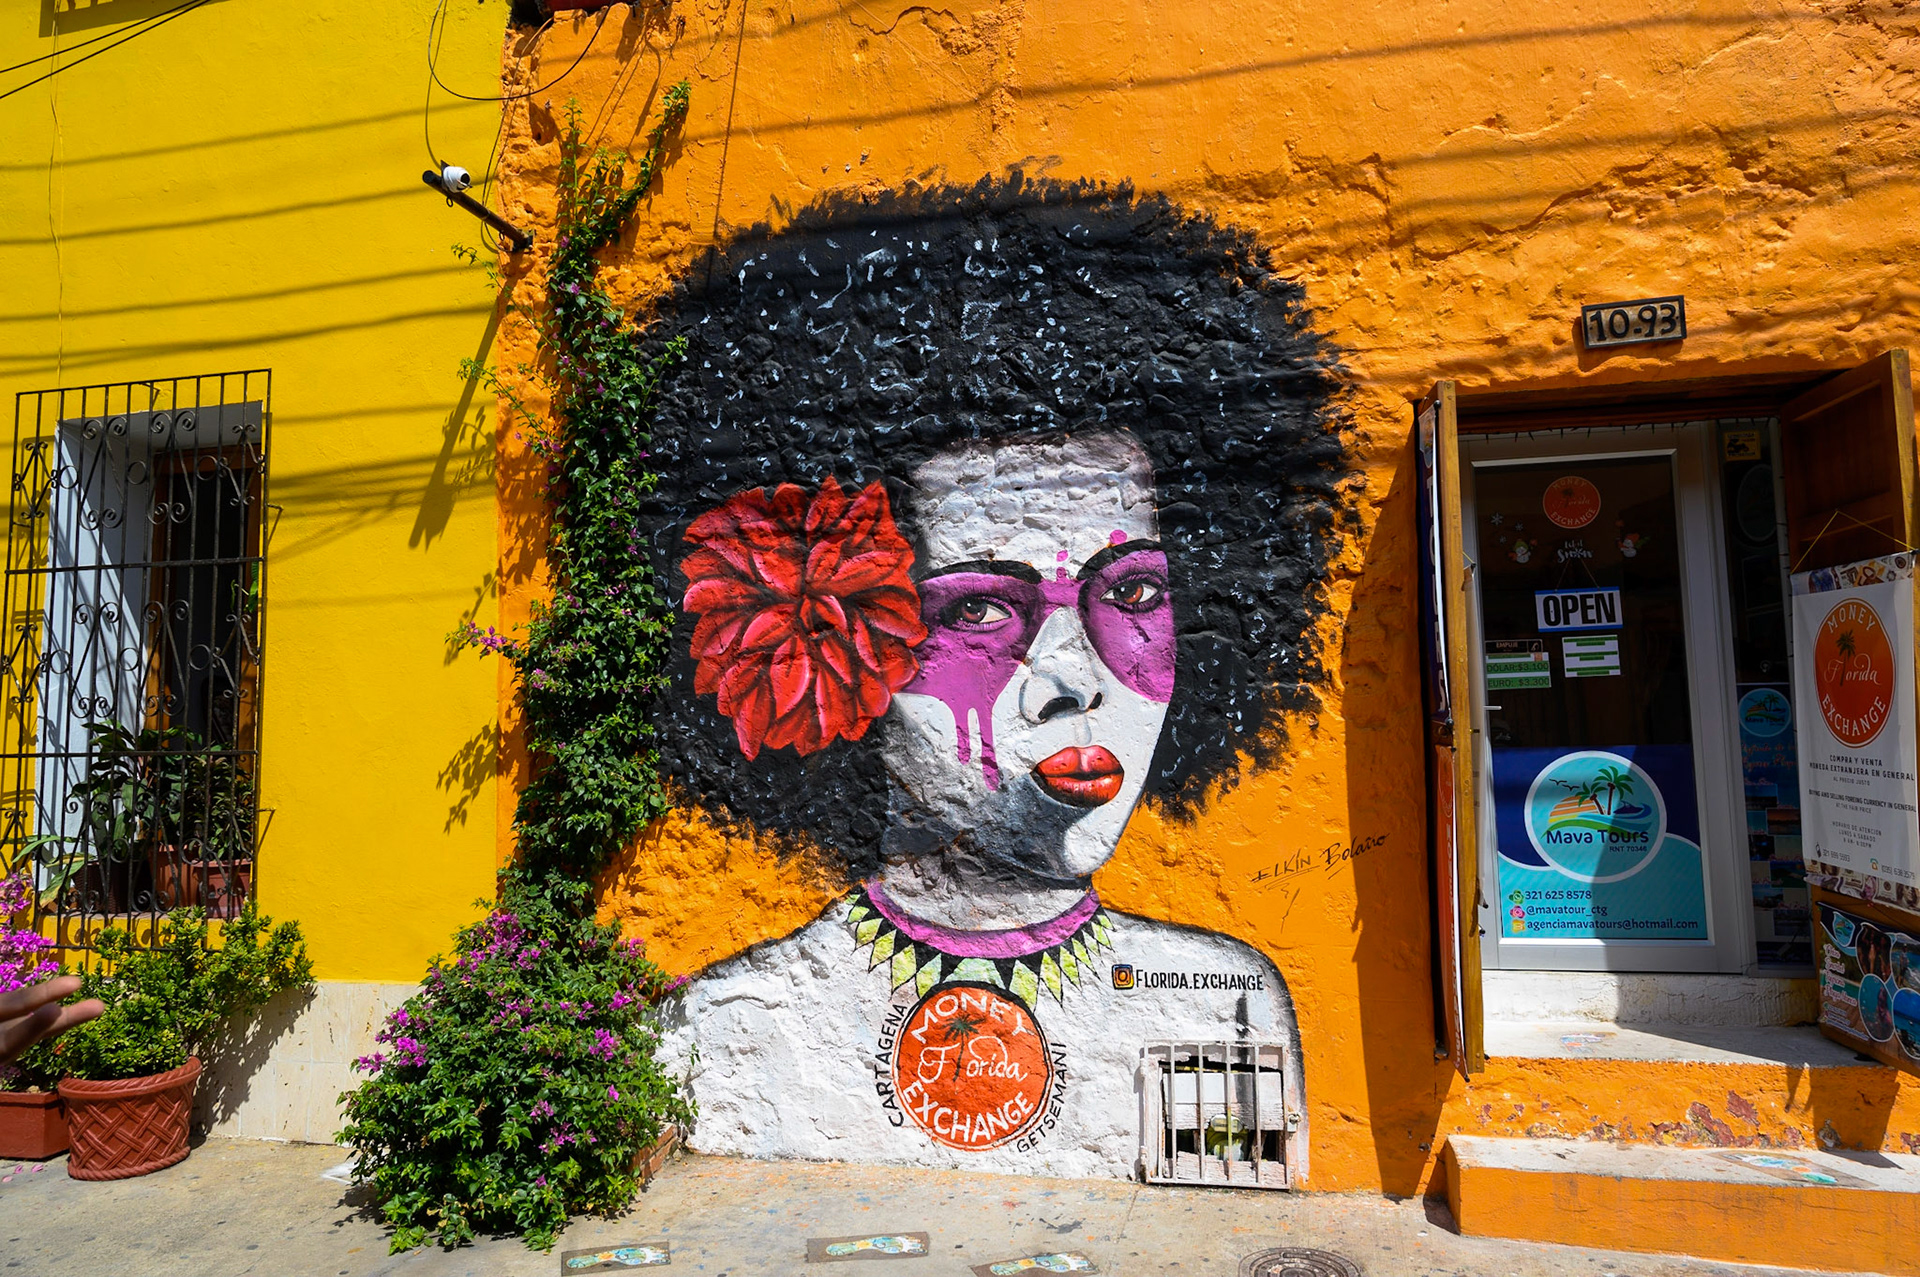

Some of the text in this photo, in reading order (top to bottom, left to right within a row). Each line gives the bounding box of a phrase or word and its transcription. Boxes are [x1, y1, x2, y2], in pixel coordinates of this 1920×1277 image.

[1550, 508, 1596, 526] EXCHANGE
[1543, 592, 1617, 627] OPEN
[1827, 604, 1876, 634] MONEY
[1823, 653, 1882, 687] Florida
[1822, 693, 1886, 737] EXCHANGE
[1830, 754, 1852, 764] COMPRA
[1861, 758, 1883, 767] VENTA
[1830, 764, 1869, 776] EXTRANJERA
[1871, 769, 1880, 778] EN
[1882, 770, 1915, 781] GENERAL
[1887, 801, 1893, 809] IN
[1894, 802, 1917, 813] GENERAL
[1547, 829, 1649, 844] Mava Tours
[1525, 890, 1592, 900] 321 625 8578
[1526, 905, 1608, 916] @mavatour_ctg
[1527, 918, 1698, 932] agenciamavatours@hotmail.com
[1136, 969, 1264, 991] FLORIDA.EXCHANGE
[911, 991, 1034, 1044] MONEY
[874, 1004, 907, 1127] CARTAGENA
[917, 1035, 1028, 1083] Florida
[1016, 1042, 1068, 1153] GETSEMANI
[903, 1080, 1034, 1143] EXCHANGE
